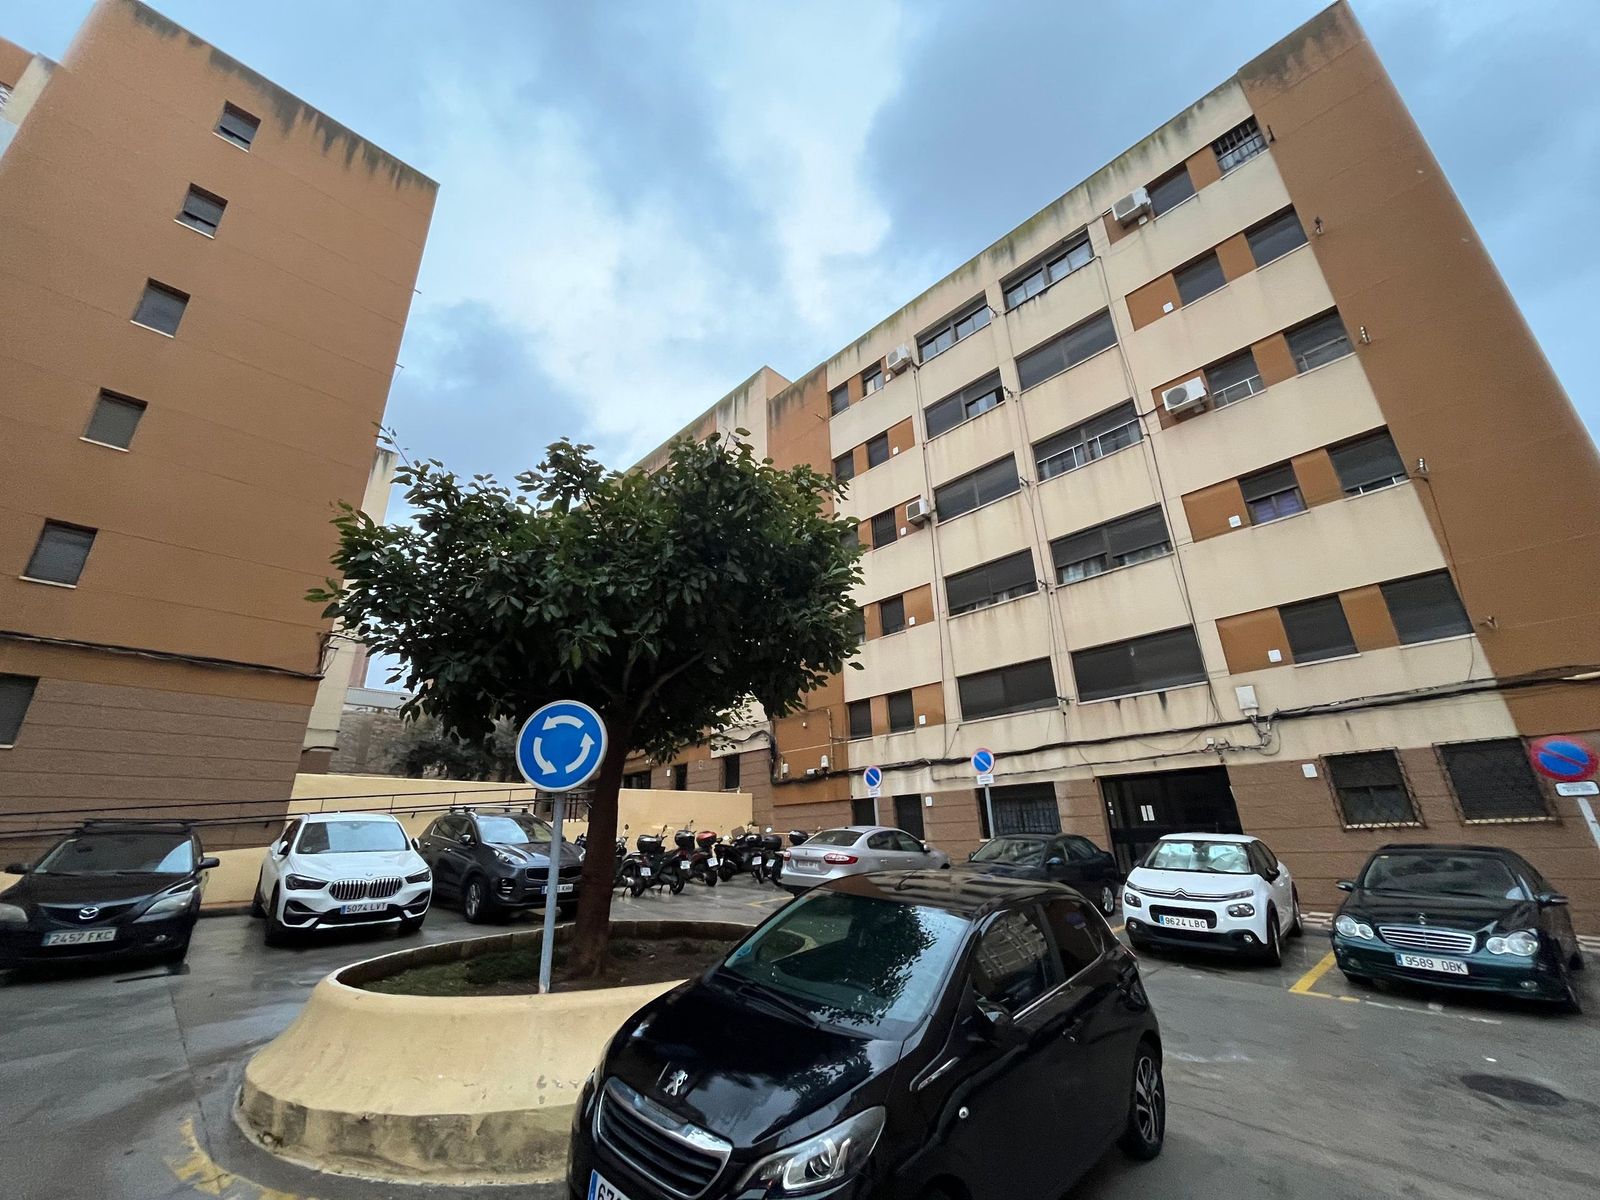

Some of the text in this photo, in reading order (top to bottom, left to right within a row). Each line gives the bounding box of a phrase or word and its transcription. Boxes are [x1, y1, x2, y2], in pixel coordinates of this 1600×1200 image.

[347, 904, 367, 912] 5074
[1165, 917, 1206, 928] 9624 LBC
[51, 931, 113, 943] 2457 FKC
[1405, 956, 1465, 972] 9589 DBK
